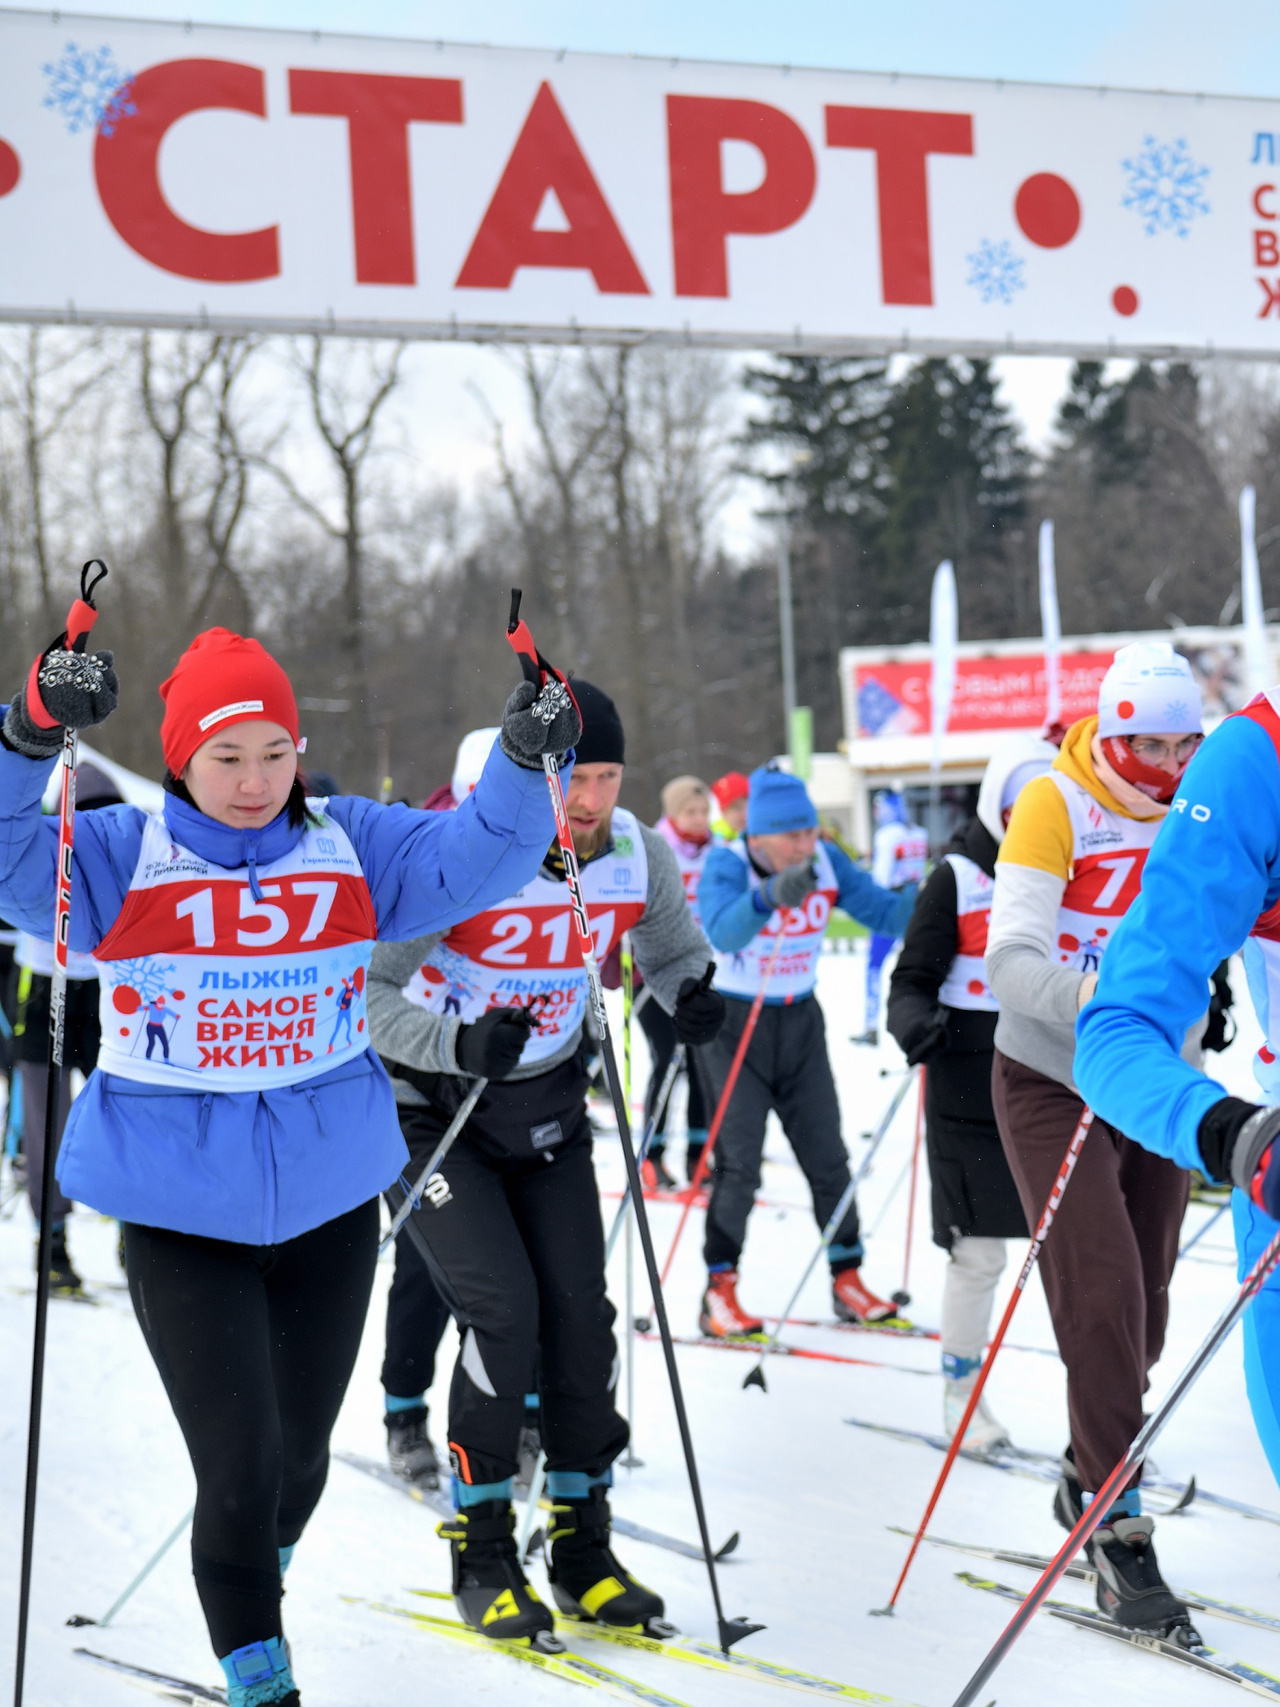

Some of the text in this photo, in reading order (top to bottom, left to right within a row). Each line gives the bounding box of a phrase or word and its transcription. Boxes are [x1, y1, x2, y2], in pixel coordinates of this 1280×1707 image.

[94, 57, 975, 307] СТАРТ
[176, 881, 338, 948] 157
[199, 966, 319, 990] ЛЫЖНЯ
[197, 993, 318, 1019] САМОЕ
[196, 1017, 315, 1042] ВРЕМЯ
[197, 1042, 315, 1068] ЖИТЬ
[615, 1633, 663, 1655] FISCHER
